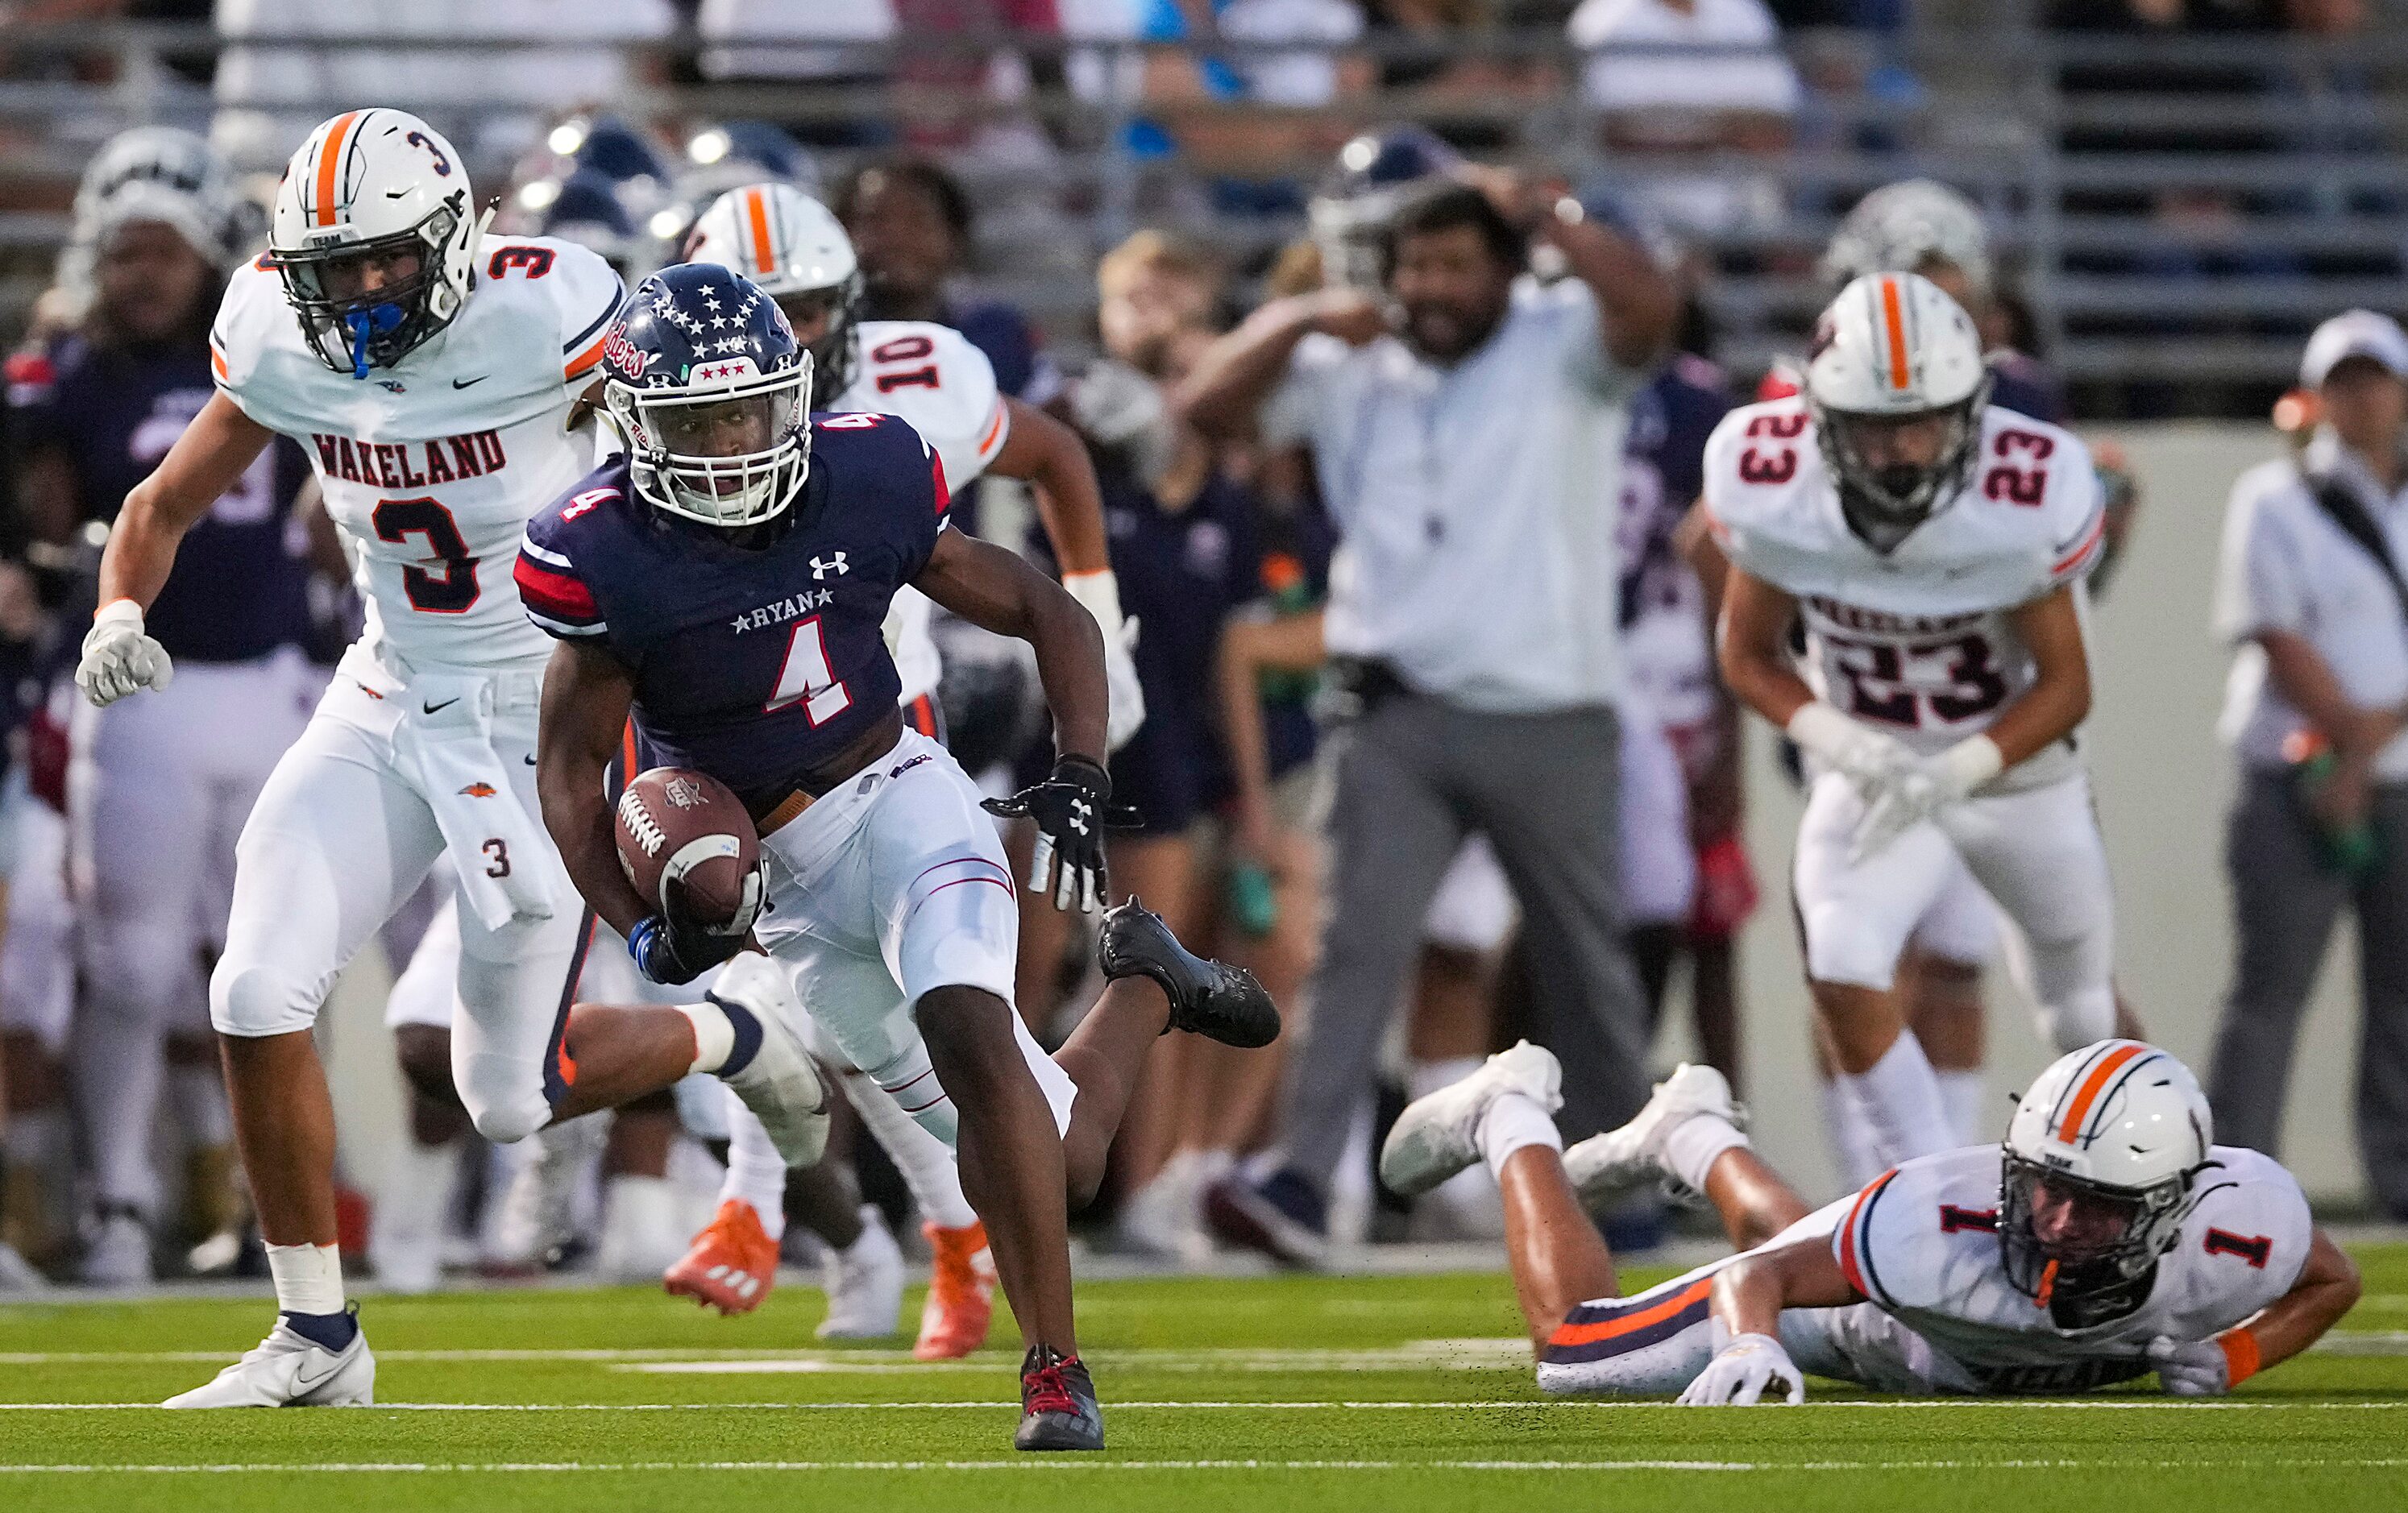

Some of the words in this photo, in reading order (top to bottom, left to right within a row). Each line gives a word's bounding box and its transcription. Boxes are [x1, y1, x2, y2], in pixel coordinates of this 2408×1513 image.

[407, 131, 450, 177] 3
[488, 245, 558, 280] 3
[871, 336, 940, 394] 10
[817, 412, 886, 431] 4
[311, 429, 506, 489] WAKELAND
[1739, 412, 1810, 484] 23
[1985, 429, 2054, 507] 23
[558, 485, 625, 524] 4
[372, 496, 481, 614] 3
[751, 591, 814, 628] RYAN
[762, 614, 854, 730] 4
[1825, 632, 2006, 729] 23
[482, 838, 511, 878] 3
[1939, 1204, 1999, 1234] 1
[2203, 1227, 2273, 1269] 1
